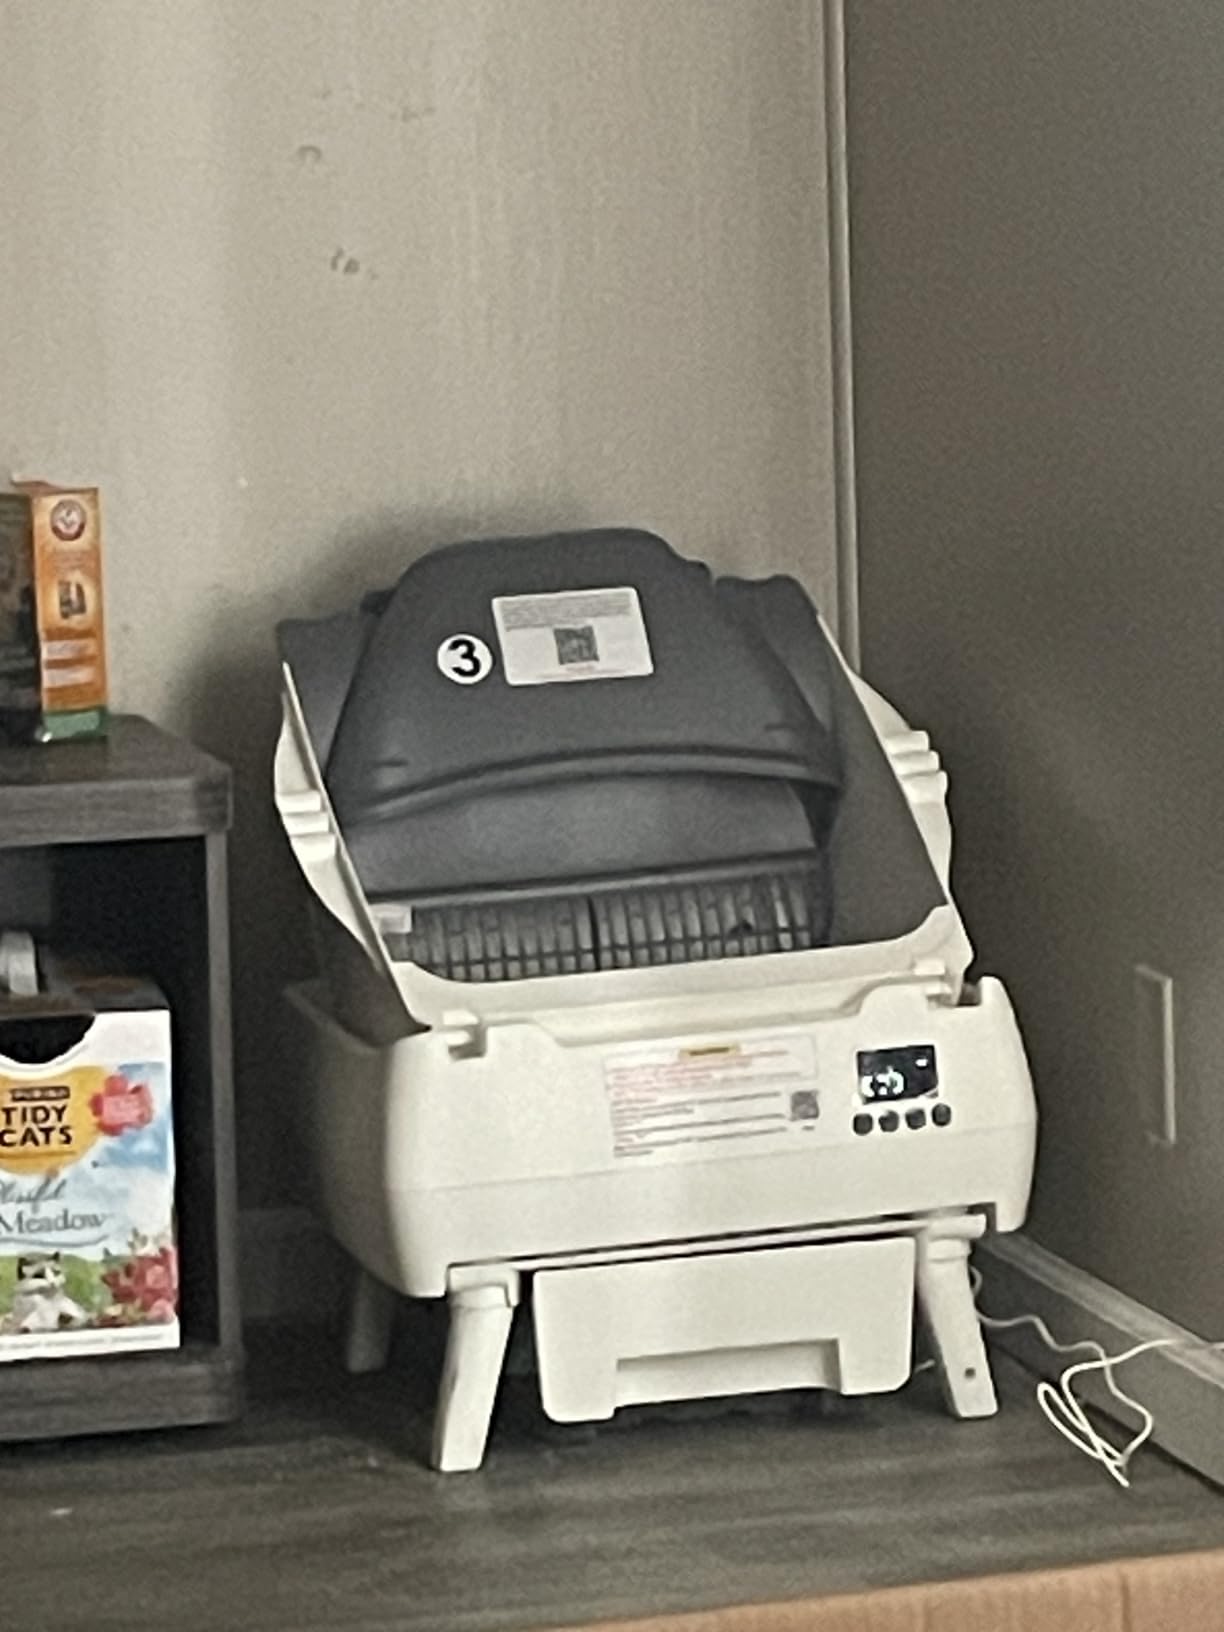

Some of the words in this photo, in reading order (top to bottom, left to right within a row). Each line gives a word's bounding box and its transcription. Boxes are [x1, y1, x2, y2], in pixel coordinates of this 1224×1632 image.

[449, 639, 481, 677] 3
[1, 1104, 68, 1126] TIDY
[0, 1125, 73, 1147] CATS
